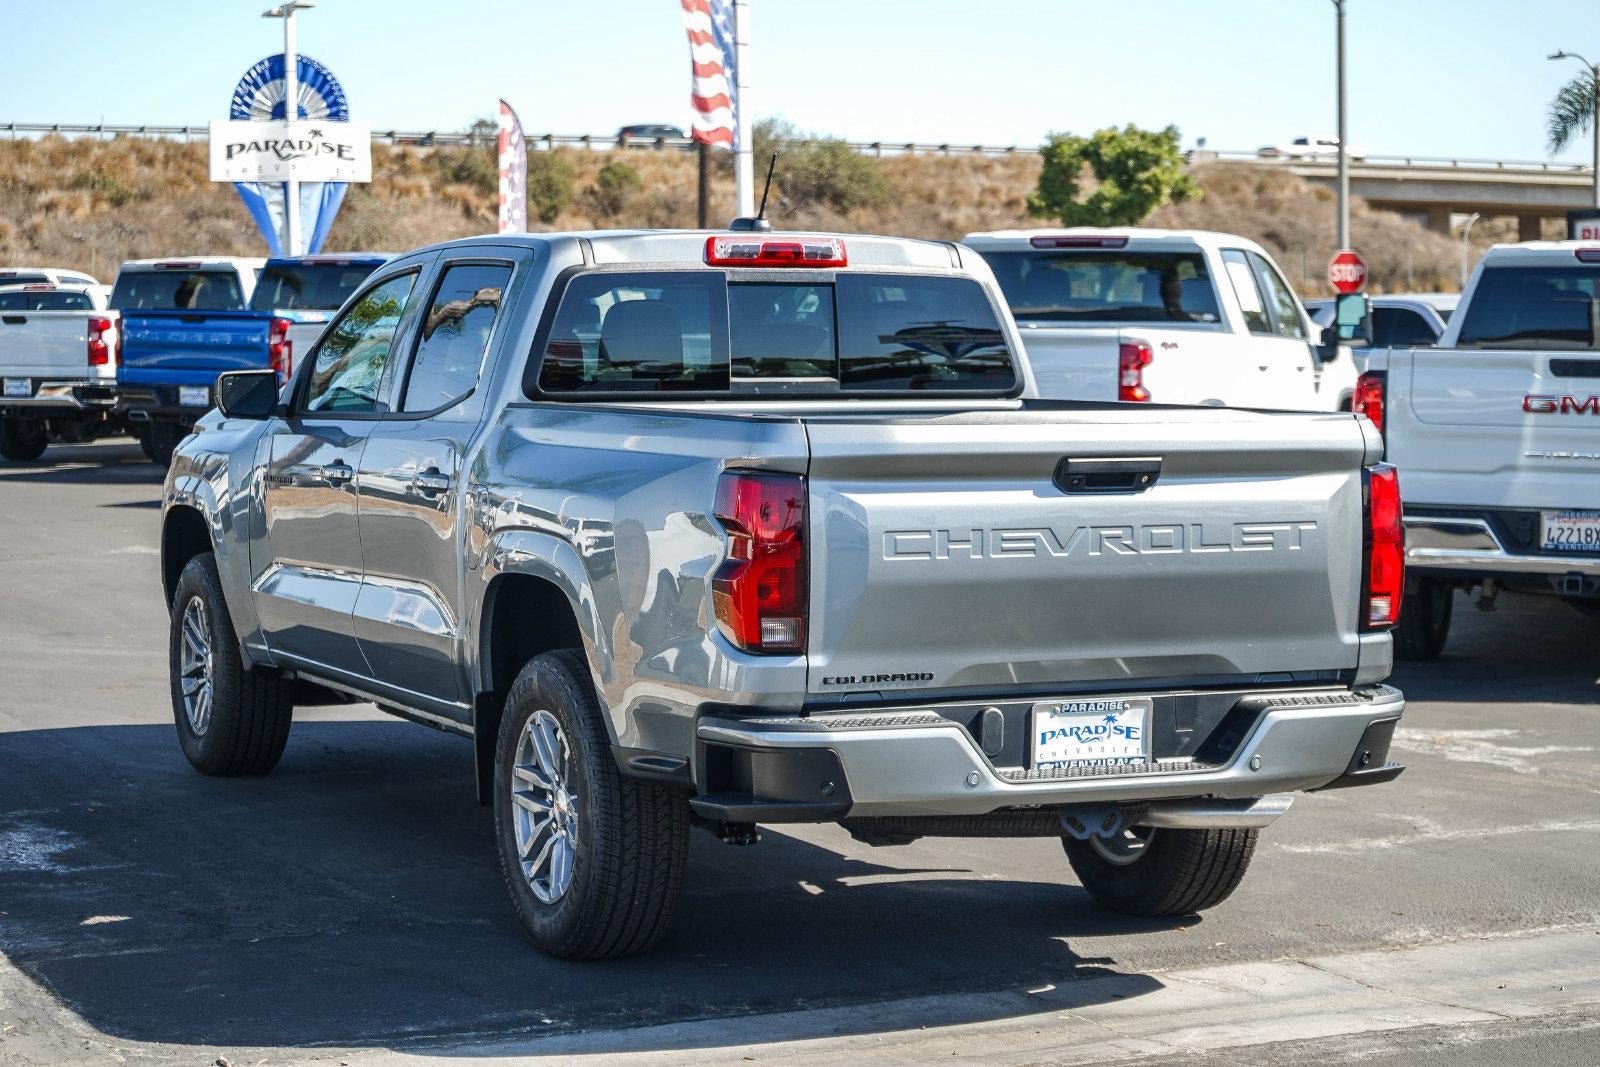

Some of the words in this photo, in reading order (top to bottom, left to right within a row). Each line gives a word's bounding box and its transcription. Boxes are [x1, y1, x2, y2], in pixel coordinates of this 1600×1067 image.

[226, 129, 356, 161] PARADISE
[1332, 264, 1364, 282] STOP
[883, 521, 1317, 560] CHEVROLET
[823, 672, 934, 685] COLORADO
[1061, 701, 1124, 713] PARADISE
[1040, 714, 1141, 745] PARADISE
[1040, 746, 1141, 760] CHEVROLET
